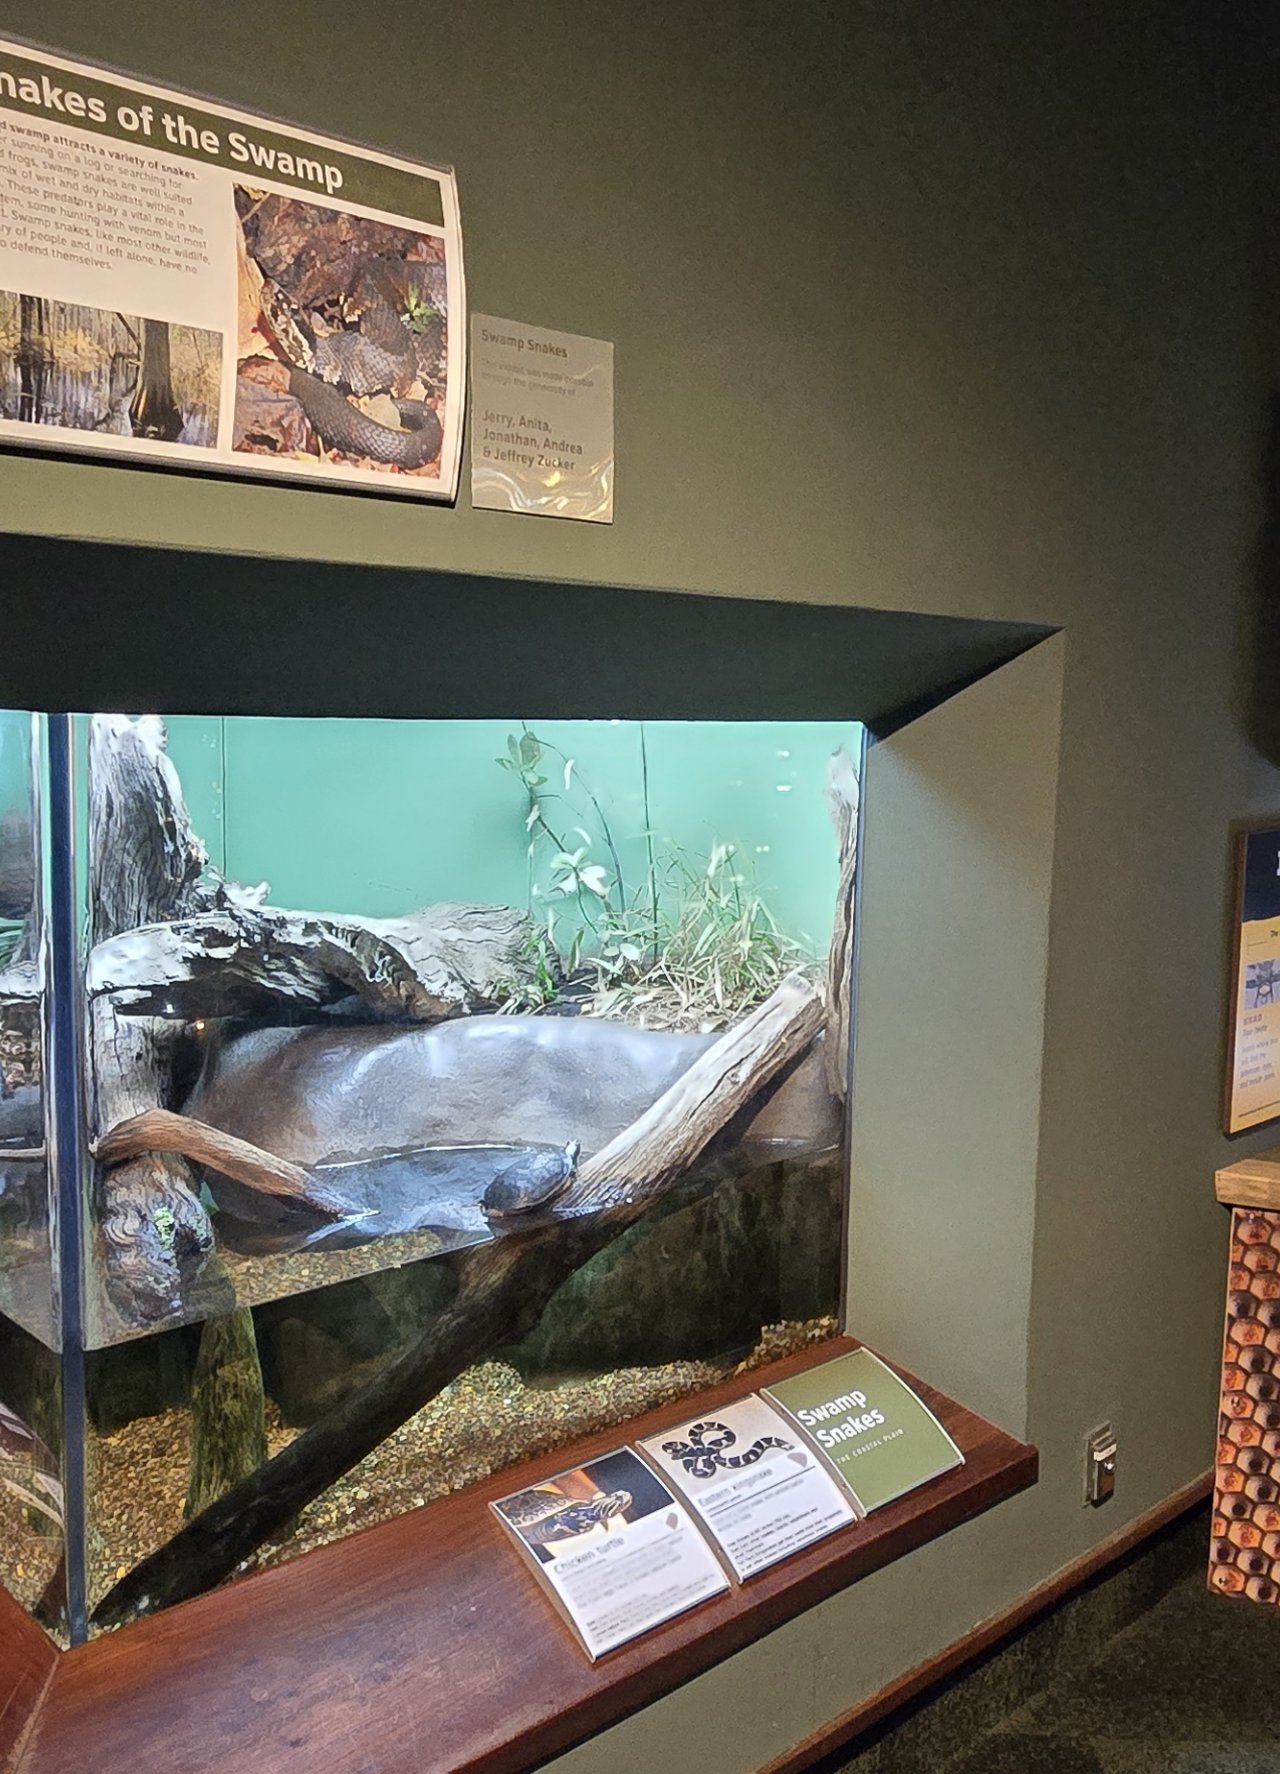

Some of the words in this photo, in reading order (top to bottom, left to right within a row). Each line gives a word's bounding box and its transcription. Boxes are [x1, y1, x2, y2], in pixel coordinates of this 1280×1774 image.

[9, 123, 50, 142] swamp
[53, 135, 97, 154] attracts
[108, 150, 145, 168] variety
[148, 161, 158, 169] of
[162, 164, 199, 180] snakes.
[11, 138, 54, 159] sunning
[57, 151, 71, 160] on
[84, 156, 100, 170] log
[104, 163, 114, 171] or
[118, 166, 166, 187] searching
[169, 178, 182, 189] for
[117, 105, 154, 135] of
[161, 113, 219, 155] the
[228, 132, 343, 194] Swamp
[21, 170, 32, 179] of
[35, 174, 56, 186] wet
[59, 179, 79, 191] and
[83, 184, 99, 197] dry
[102, 189, 143, 207] habitats
[146, 201, 176, 215] within
[179, 209, 184, 217] a
[42, 161, 79, 178] swamp
[83, 171, 118, 186] snakes
[121, 181, 137, 191] are
[140, 186, 160, 197] well
[163, 191, 192, 205] suited
[7, 179, 39, 196] These
[43, 190, 93, 209] predators
[97, 203, 118, 216] play
[122, 209, 127, 217] a
[130, 211, 152, 222] vital
[155, 216, 173, 228] role
[177, 220, 185, 231] in
[188, 224, 204, 235] the
[27, 201, 56, 214] some
[60, 206, 100, 227] hunting
[103, 218, 125, 230] with
[128, 224, 162, 238] venom
[165, 231, 180, 243] but
[184, 237, 206, 249] most
[10, 241, 48, 256] defend
[11, 210, 51, 229] Swamp
[96, 229, 114, 241] like
[117, 236, 142, 248] most
[145, 242, 170, 254] other
[15, 227, 26, 236] of
[30, 230, 67, 245] people
[96, 243, 102, 253] if
[106, 246, 123, 258] left
[159, 258, 182, 271] have
[185, 264, 197, 274] no
[481, 329, 524, 352] Swamp
[528, 339, 568, 358] Snakes
[482, 410, 515, 428] Jerry,
[519, 415, 552, 433] Anita,
[483, 428, 540, 450] Jonathan,
[543, 438, 583, 455] Andrea
[483, 446, 491, 458] &
[494, 448, 534, 468] Jeffrey
[538, 454, 576, 470] Zucker
[797, 1390, 867, 1426] Swamp
[816, 1409, 885, 1448] Snakes
